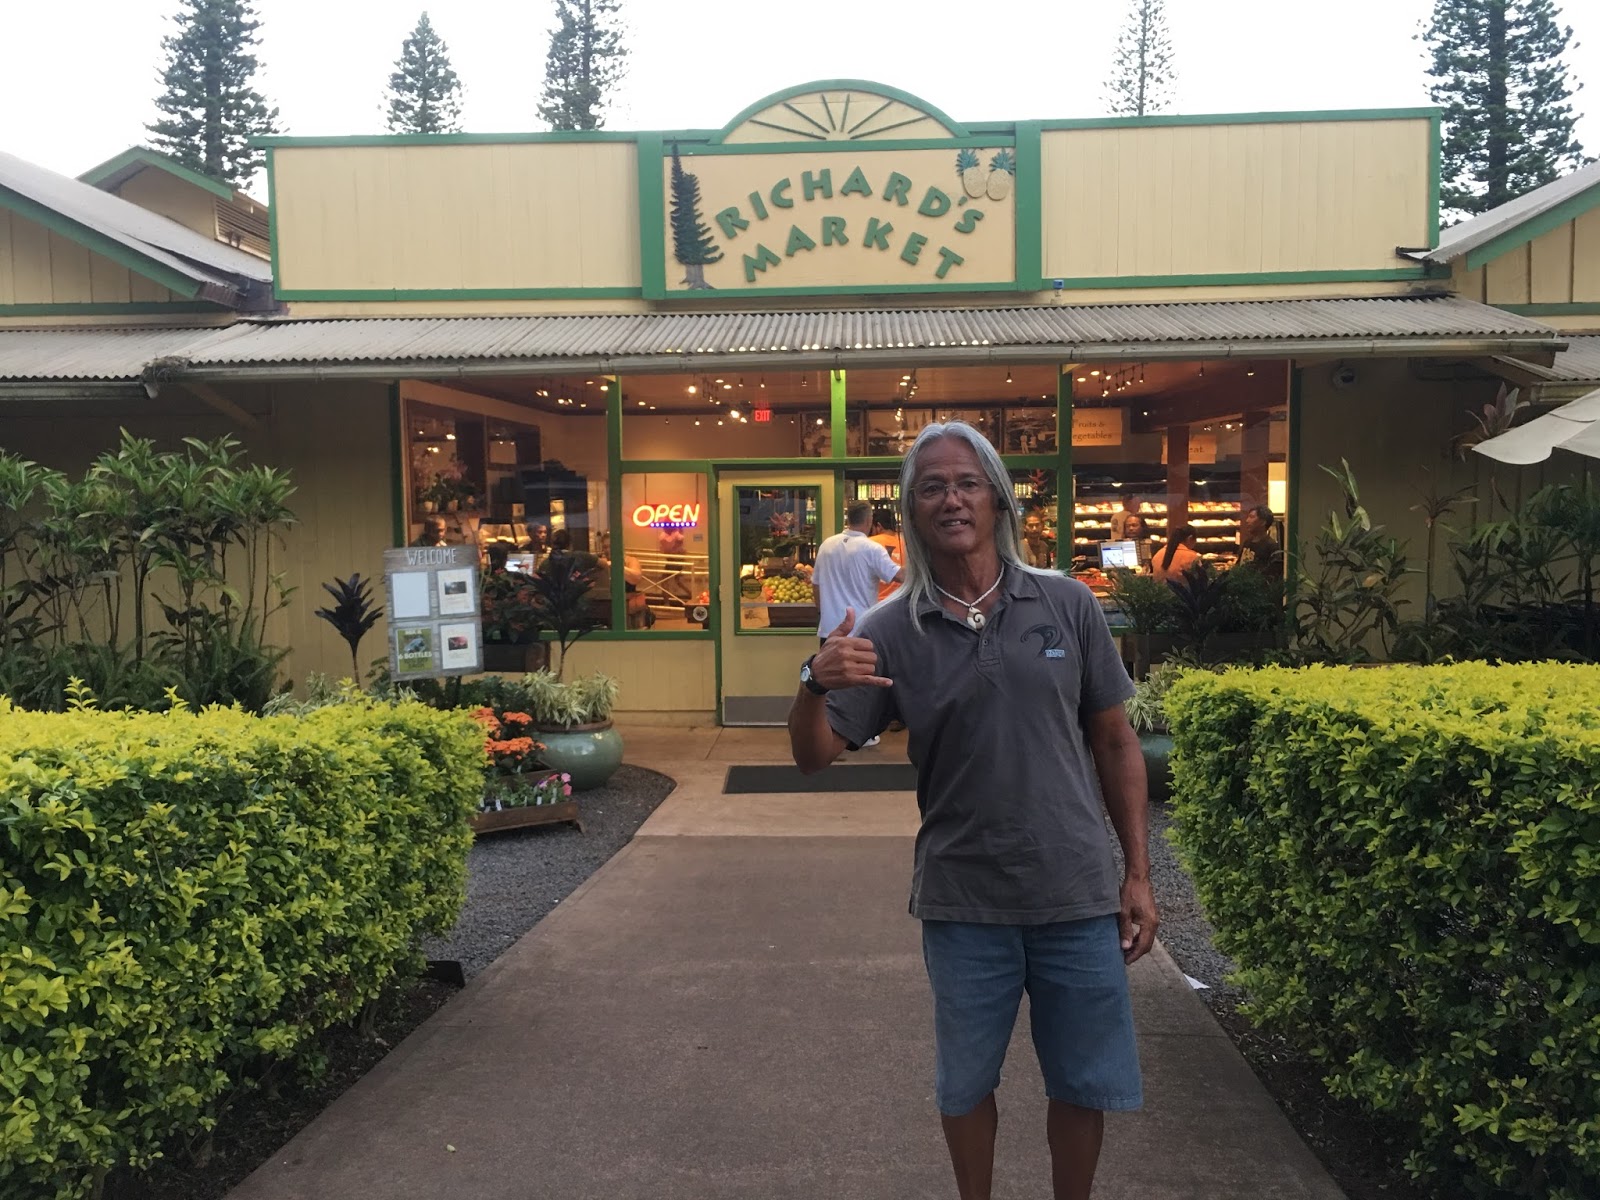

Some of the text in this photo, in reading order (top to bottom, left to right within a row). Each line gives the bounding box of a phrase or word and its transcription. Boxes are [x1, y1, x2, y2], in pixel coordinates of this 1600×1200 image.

[715, 165, 984, 240] RICHARD'S
[743, 216, 965, 283] MARKET
[755, 410, 770, 422] EXIT
[1072, 430, 1112, 442] egetables
[632, 504, 700, 527] OPEN
[406, 548, 457, 565] WELCOME
